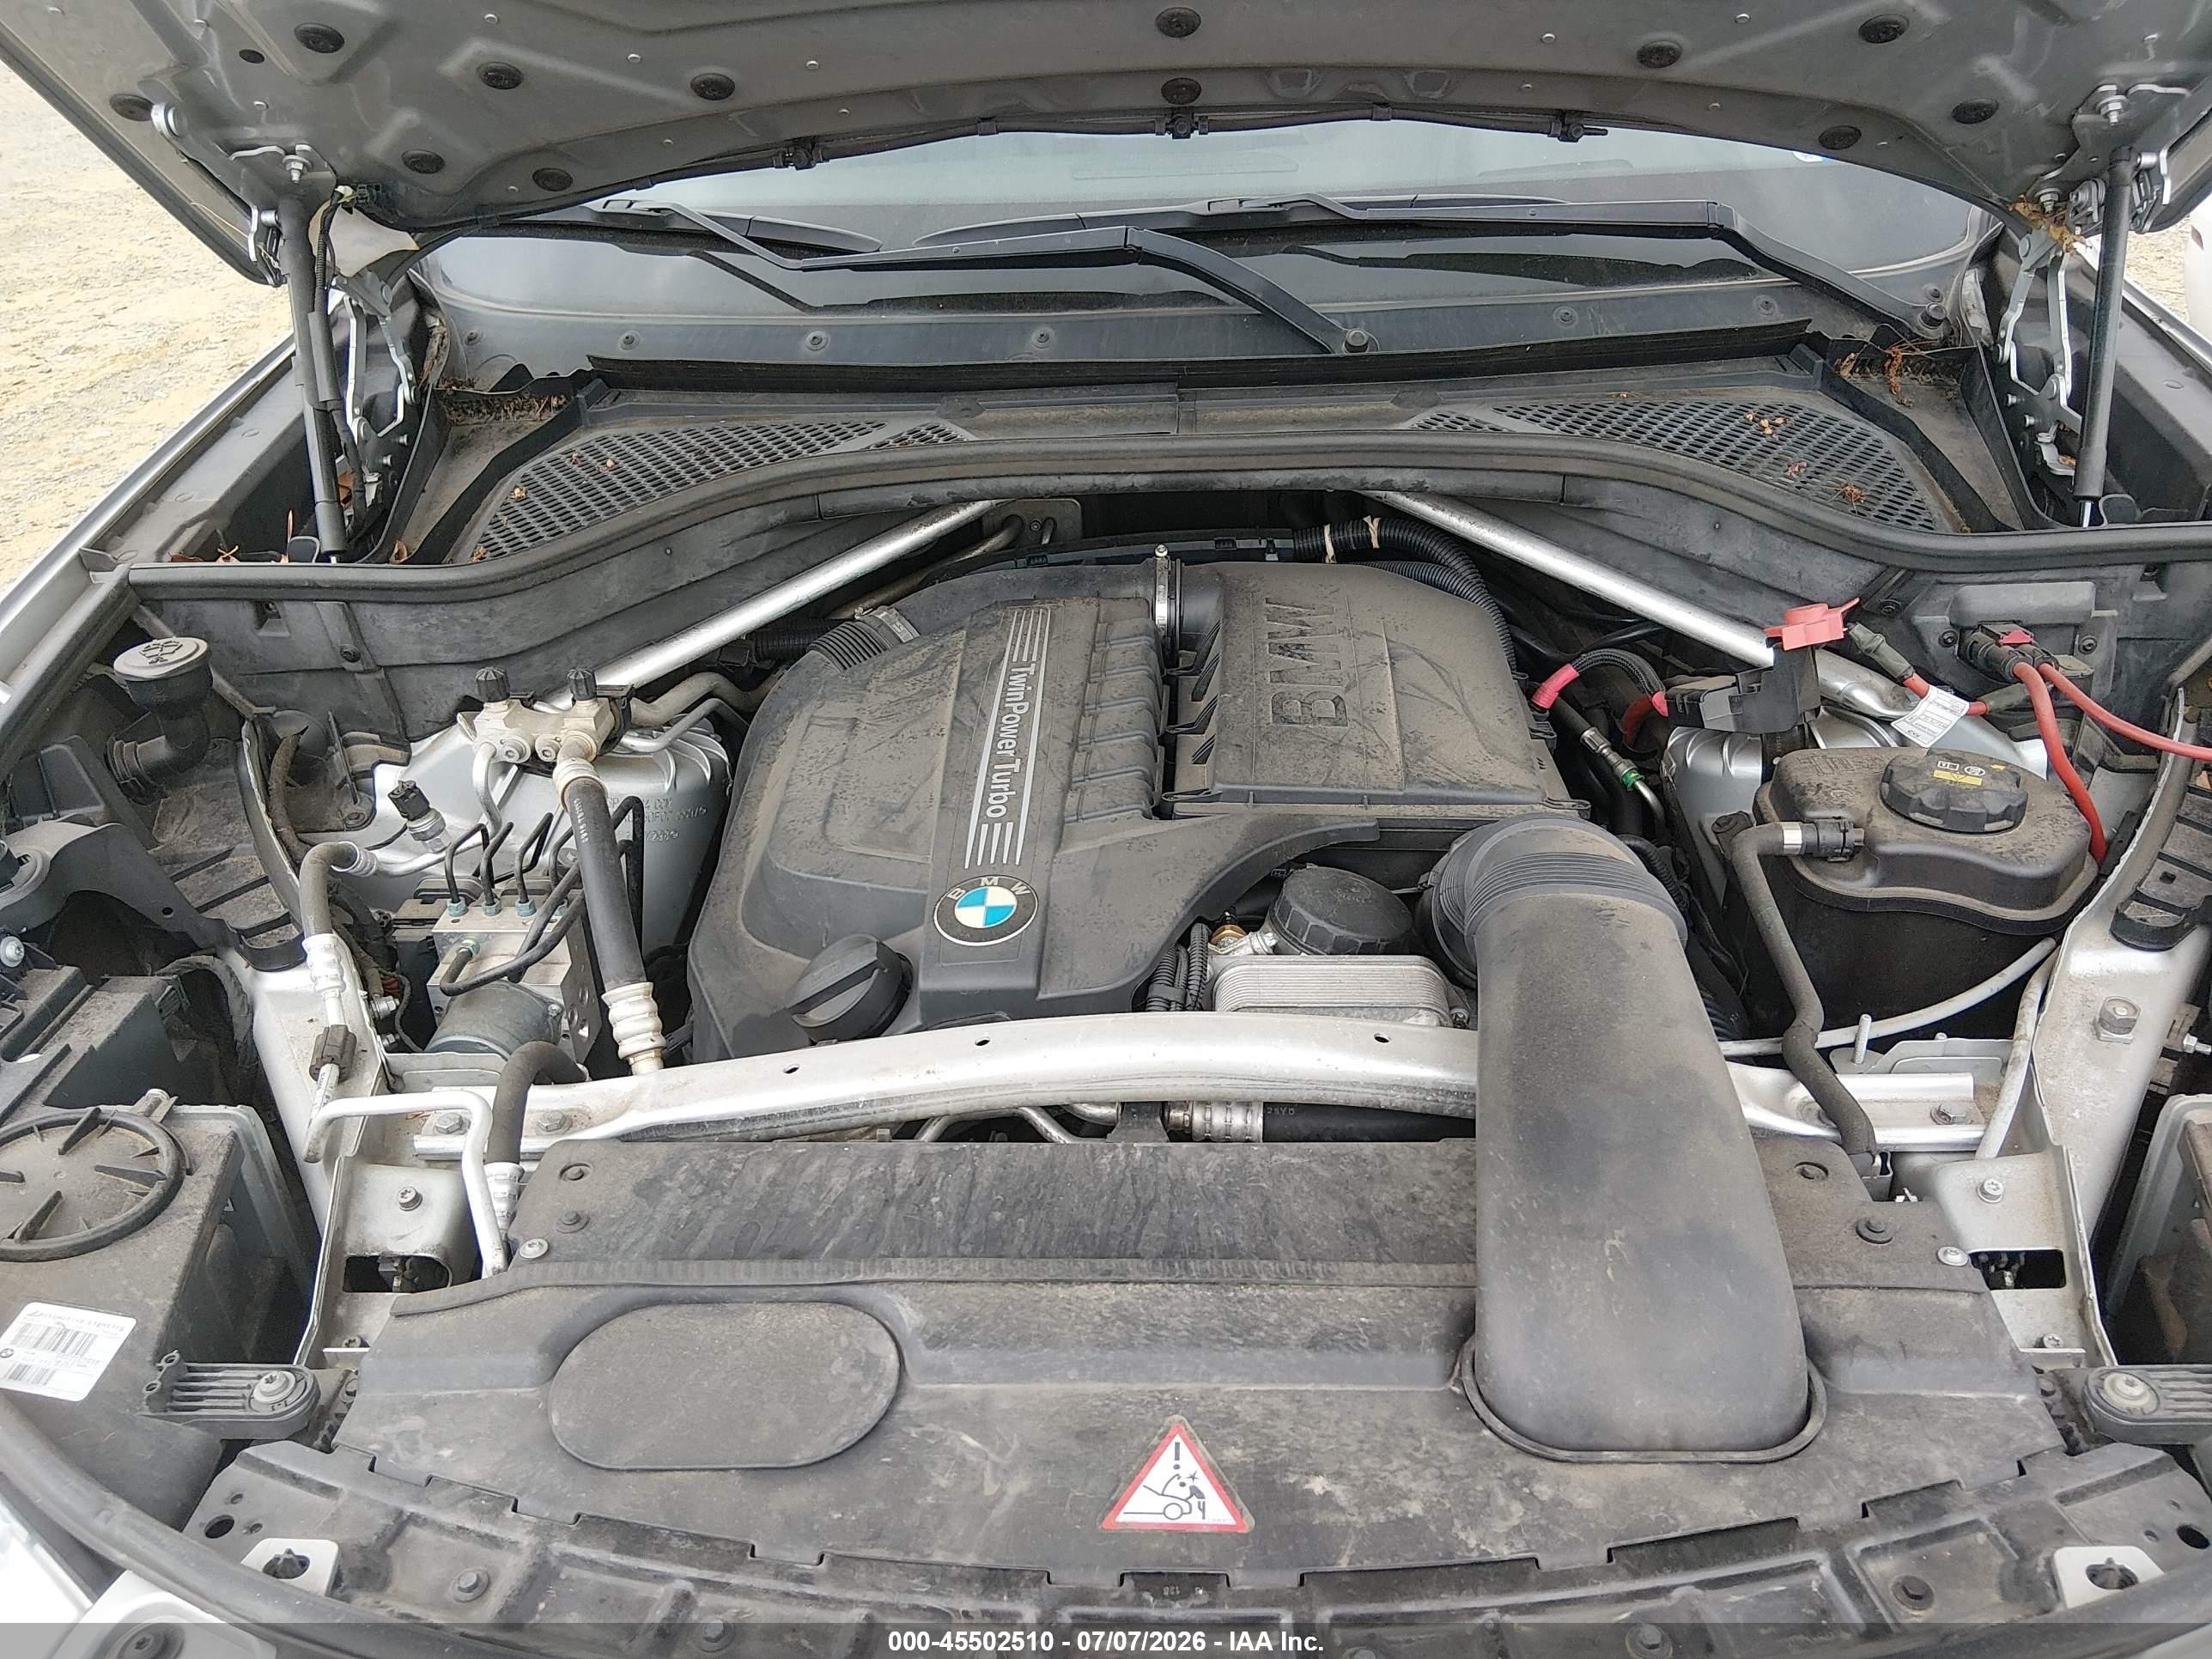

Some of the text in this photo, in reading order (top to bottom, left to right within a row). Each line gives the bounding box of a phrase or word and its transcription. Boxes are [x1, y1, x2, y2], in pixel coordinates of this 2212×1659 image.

[1264, 597, 1348, 727] BMW
[986, 659, 1035, 817] TwinPower Turbo
[947, 877, 1030, 901] BMW
